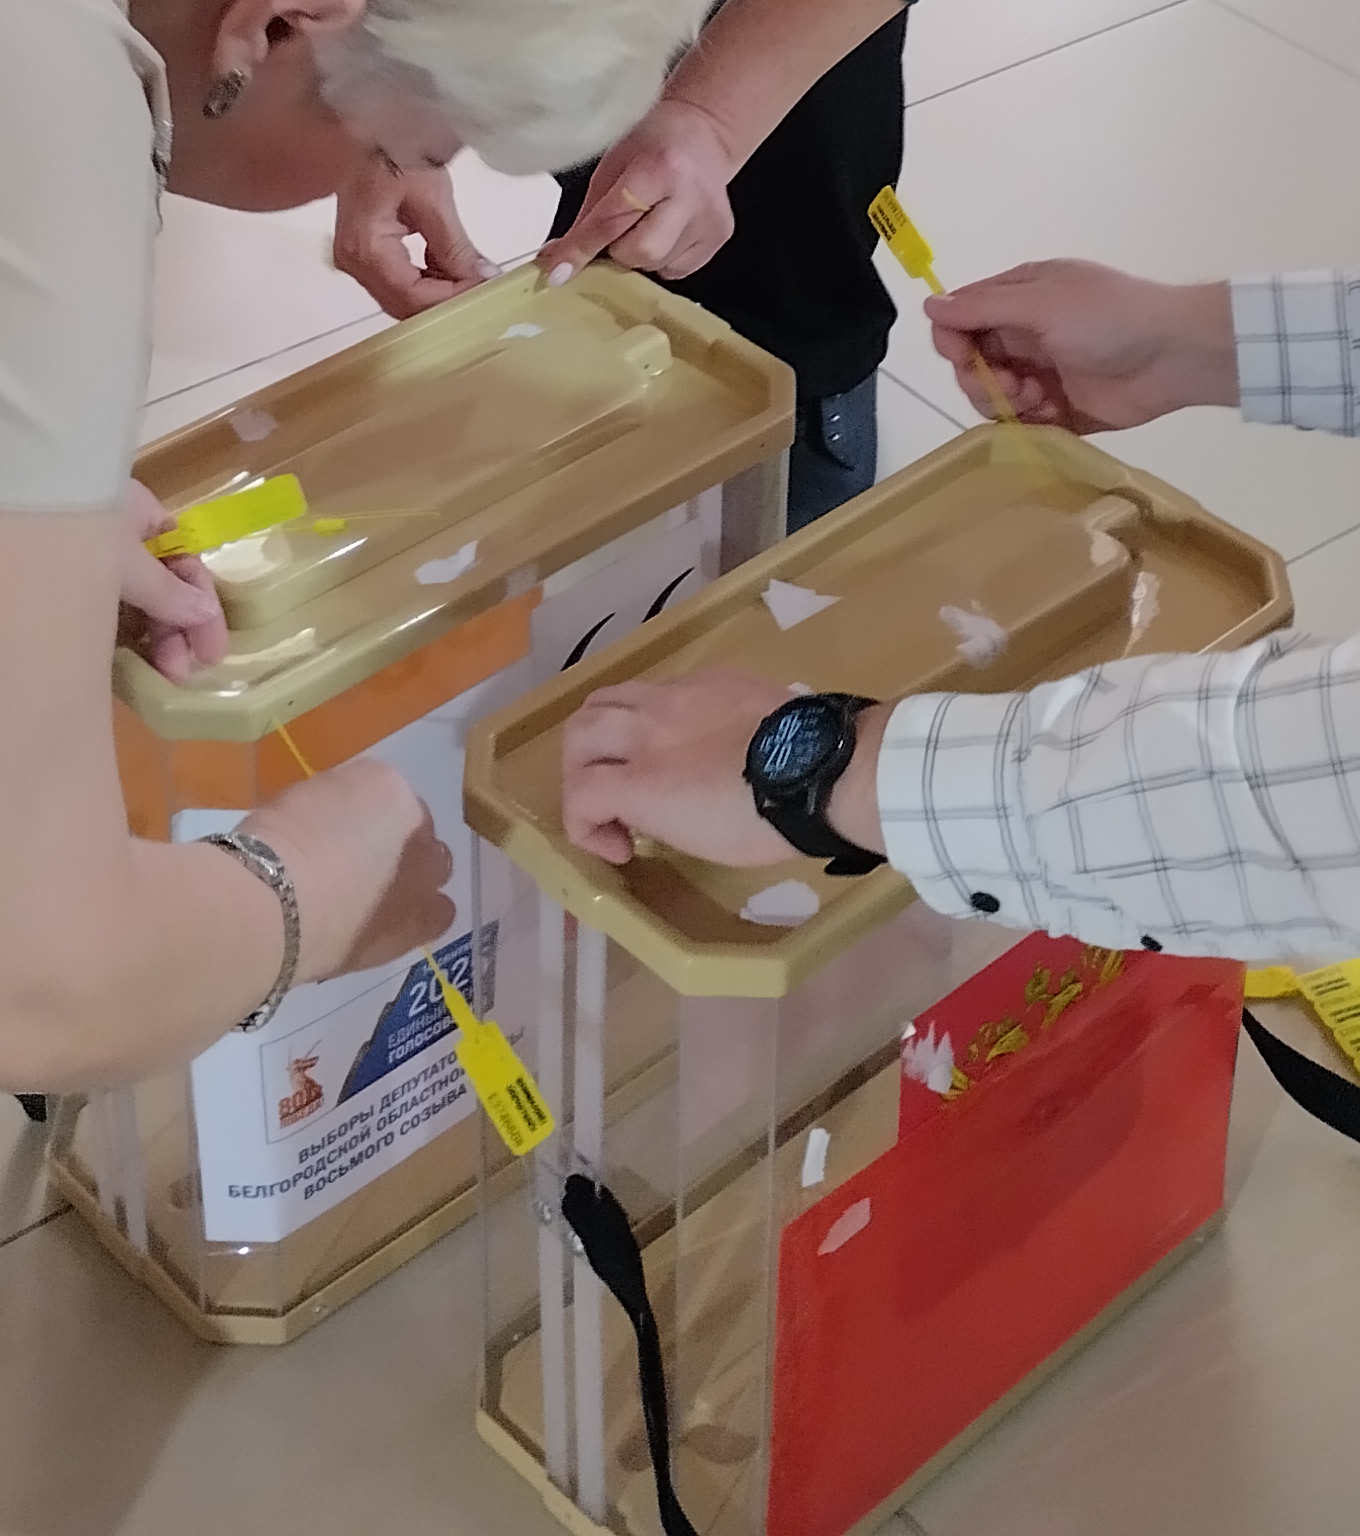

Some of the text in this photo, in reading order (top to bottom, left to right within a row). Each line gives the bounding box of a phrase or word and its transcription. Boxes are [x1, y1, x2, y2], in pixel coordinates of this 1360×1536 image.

[408, 955, 474, 1018] 202
[297, 1103, 375, 1165] ВЫБОРЫ
[378, 1049, 458, 1114] ДЕПУТАТО
[303, 1131, 395, 1202] ВОСЬМОГО
[399, 1082, 468, 1136] СОЗЫВА
[228, 1123, 371, 1200] БЕЛГОРОДСКОЙ
